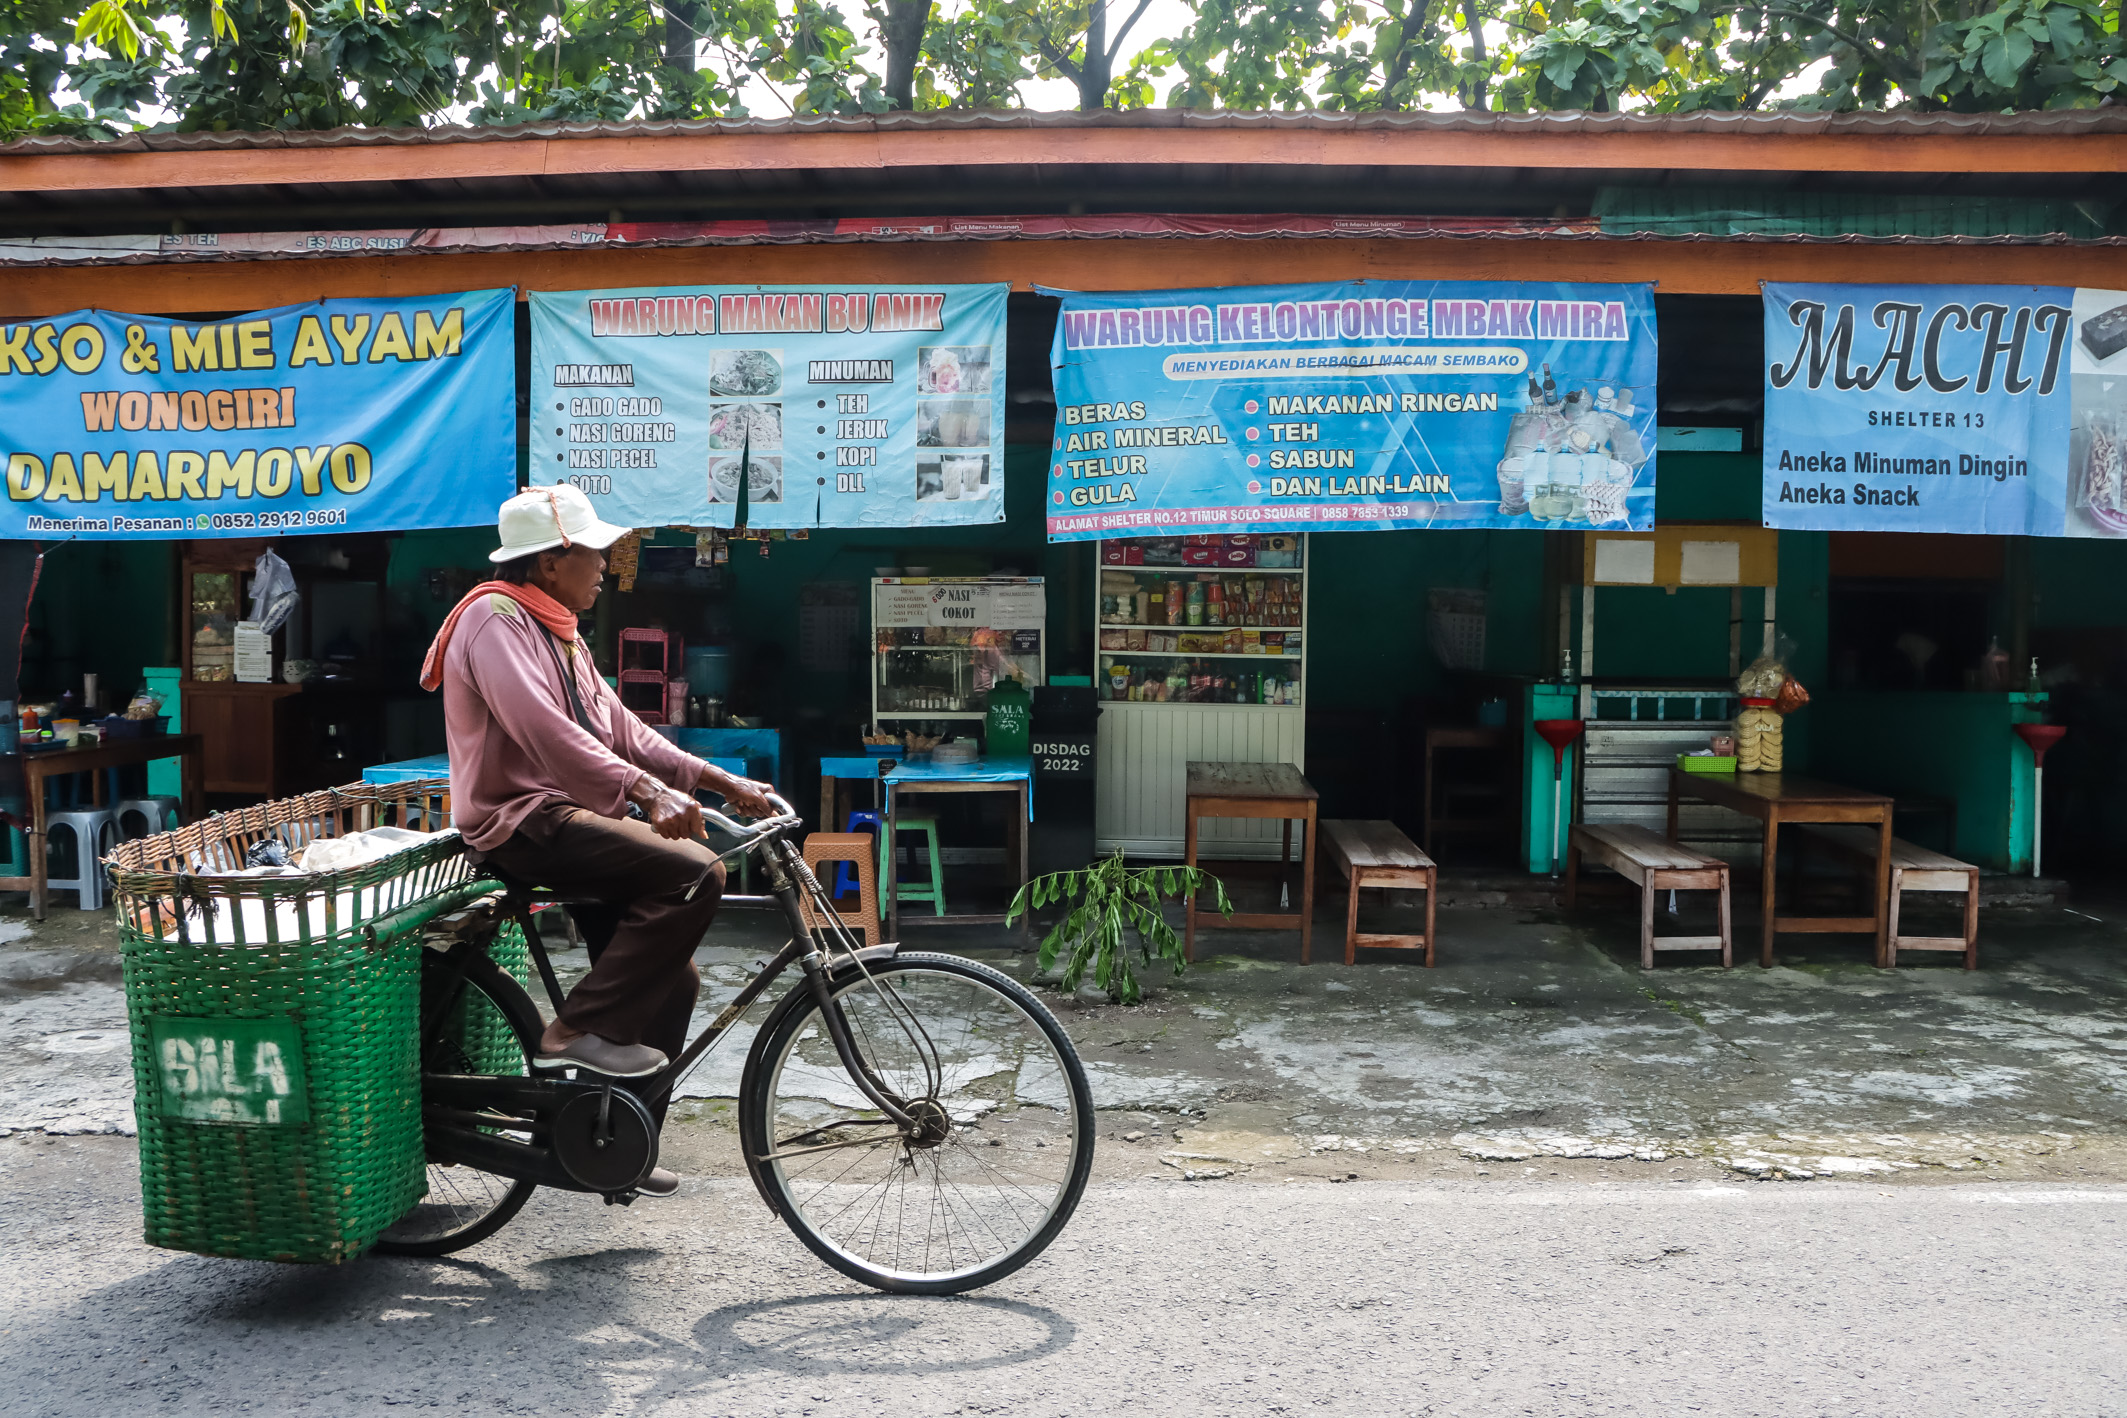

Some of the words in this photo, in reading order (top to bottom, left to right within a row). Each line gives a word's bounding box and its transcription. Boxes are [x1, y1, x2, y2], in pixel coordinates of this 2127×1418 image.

[188, 233, 218, 246] TEH
[306, 237, 326, 249] ES
[330, 237, 363, 249] ABC
[590, 295, 715, 337] WARUNG
[719, 293, 821, 333] MAKAN
[825, 293, 869, 333] BU
[870, 292, 946, 332] ANIK
[1063, 305, 1212, 351] WARUNG
[1217, 299, 1427, 343] KELONTONGE
[1431, 298, 1535, 341] MBAK
[1537, 298, 1629, 341] MIRA
[0, 323, 106, 376] KSO
[121, 324, 159, 373] &
[169, 318, 276, 372] MIE
[290, 307, 465, 367] AYAM
[1769, 299, 2073, 395] MACHI
[810, 360, 893, 382] MINUMAN
[1172, 358, 1291, 373] MENYEDIAKAN
[1296, 356, 1375, 369] BERBAGAI
[1379, 354, 1437, 367] MACAM
[1442, 354, 1520, 367] SEMBAKO
[555, 364, 633, 388] MAKANAN
[80, 387, 297, 432] WONOGIRI
[570, 397, 614, 417] GADO
[616, 396, 662, 417] GADO
[837, 394, 868, 414] TEH
[1065, 401, 1146, 426] BERAS
[1268, 393, 1393, 415] MAKANAN
[1400, 392, 1498, 413] RINGAN
[836, 419, 888, 440] JERUK
[1868, 410, 1956, 428] SHELTER
[1963, 413, 1985, 428] 13
[569, 423, 607, 442] NASI
[610, 422, 675, 443] GORENG
[1066, 431, 1109, 453] AIR
[1114, 425, 1228, 448] MINERAL
[1268, 422, 1319, 442] TEH
[569, 449, 607, 469] NASI
[610, 448, 657, 469] PECEL
[837, 446, 877, 467] KOPI
[1067, 455, 1148, 479] TELUR
[1269, 449, 1355, 469] SABUN
[1778, 450, 1847, 473] Aneka
[1853, 452, 1951, 475] Minuman
[1958, 454, 2028, 482] Dingin
[6, 442, 372, 502] DAMARMOYO
[837, 472, 865, 492] DLL
[1070, 482, 1137, 507] GULA
[1270, 476, 1322, 496] DAN
[1328, 474, 1450, 496] LAIN-LAIN
[1779, 481, 1846, 504] Aneka
[1852, 483, 1920, 506] Snack
[27, 515, 108, 531] Menerima
[112, 516, 182, 531] Pesanan
[212, 514, 254, 529] 0852
[258, 512, 301, 528] 2912
[305, 508, 347, 525] 9601
[1055, 516, 1100, 531] ALAMAT
[1102, 513, 1151, 528] SHELTER
[1154, 511, 1187, 525] NO.12
[1190, 509, 1228, 522] TIMUR
[1230, 508, 1261, 521] SOLO
[1263, 507, 1310, 520] SQUARE
[1322, 507, 1349, 519] 0858
[948, 589, 971, 602] NASI
[942, 607, 976, 619] COKOT
[1033, 744, 1091, 756] DISDAG
[1043, 759, 1080, 771] 2022
